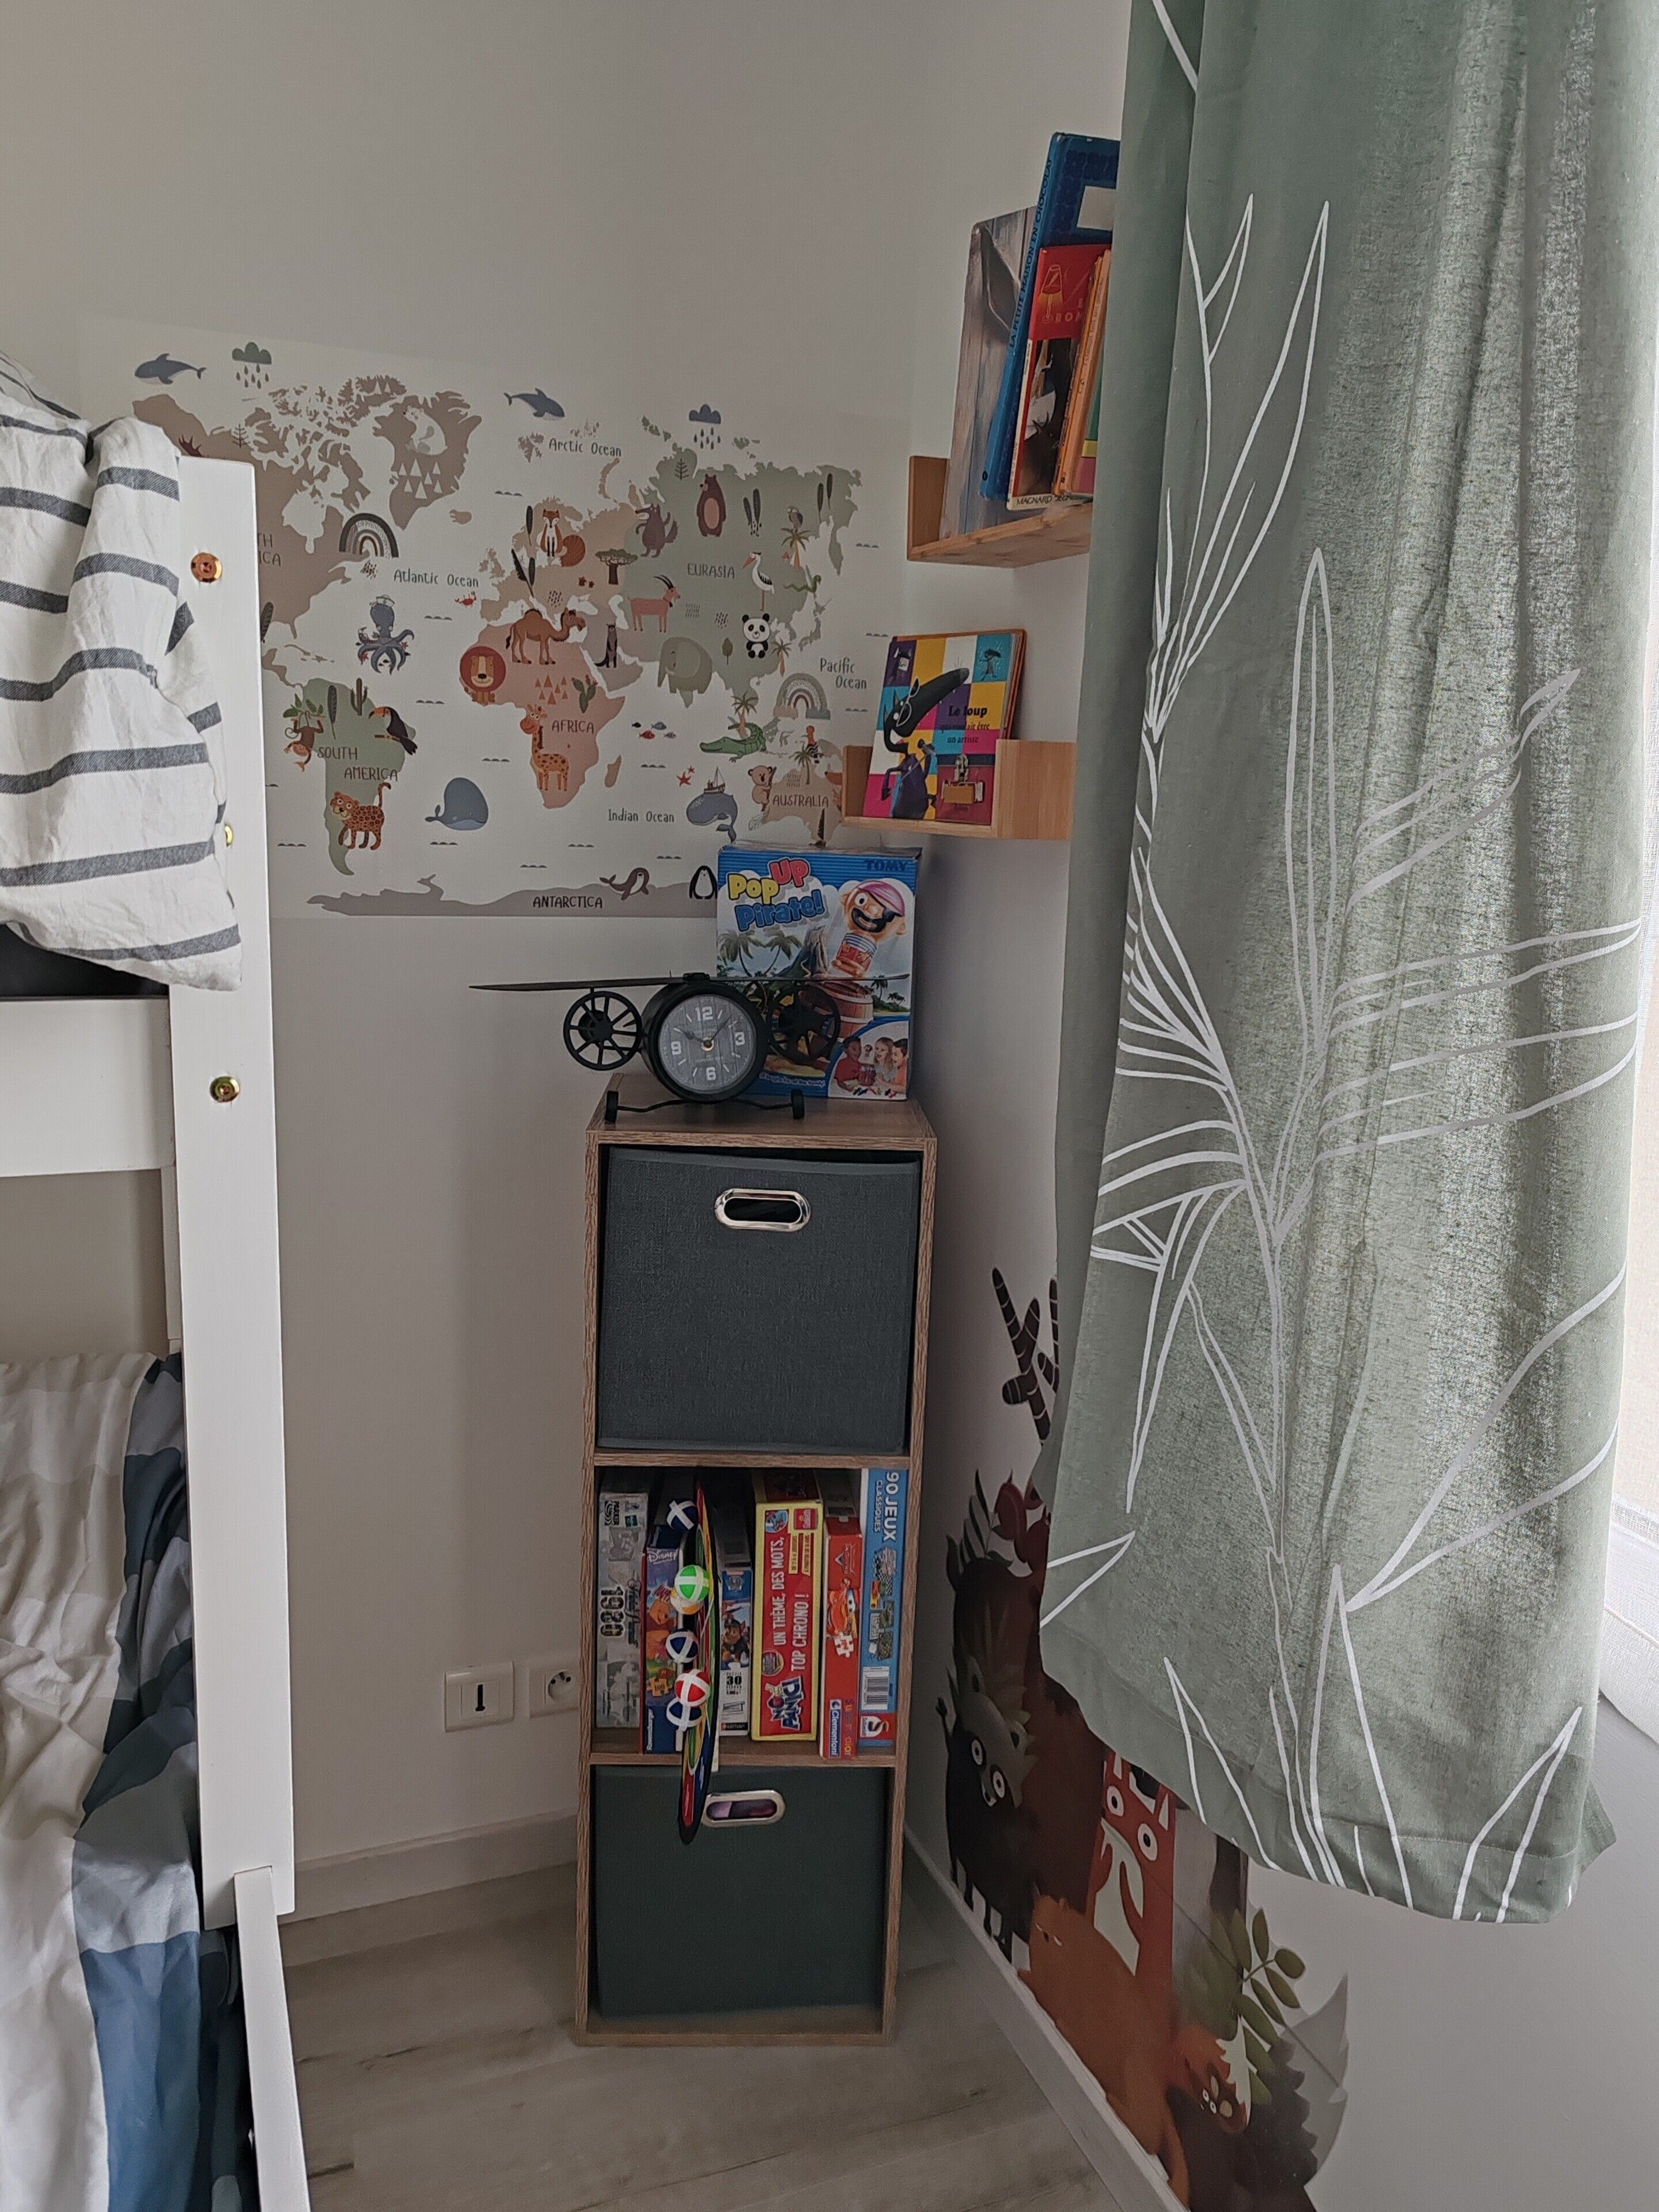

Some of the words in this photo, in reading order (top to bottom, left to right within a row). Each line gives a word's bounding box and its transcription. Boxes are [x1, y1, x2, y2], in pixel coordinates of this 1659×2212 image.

[1034, 158, 1054, 224] CHOCOLAT
[1030, 227, 1039, 243] EN
[1020, 246, 1035, 293] MAISON
[1012, 296, 1025, 331] PETITE
[1007, 334, 1017, 348] LA
[549, 438, 584, 453] Arctic
[590, 441, 622, 457] Ocean
[1017, 495, 1052, 506] MAGNARD
[393, 568, 439, 585] Atlantic
[447, 572, 479, 588] Ocean
[687, 563, 736, 579] EURASIA
[820, 657, 855, 674] Pacific
[836, 674, 868, 690] Ocean
[949, 706, 960, 717] Le
[964, 706, 987, 718] loup
[551, 719, 595, 734] AFRICA
[317, 744, 358, 760] SOUTH
[344, 766, 399, 782] AMERICA
[772, 794, 830, 808] AUSTRALIA
[608, 808, 639, 823] Indian
[646, 809, 675, 824] Ocean
[864, 858, 908, 871] TOMY
[532, 895, 603, 909] ANTARCTICA
[734, 889, 825, 931] Pirate!
[695, 1006, 713, 1021] 12
[735, 1032, 746, 1046] 3
[671, 1041, 681, 1055] 9
[706, 1067, 717, 1081] 6
[885, 1472, 900, 1494] 90
[873, 1479, 882, 1533] CLASSIQUES
[882, 1496, 899, 1541] JEUX
[770, 1536, 786, 1569] MOTS,
[771, 1571, 785, 1589] DES
[601, 1586, 626, 1637] 1980
[770, 1593, 787, 1629] THÈME,
[791, 1603, 809, 1647] CHRONO
[773, 1631, 787, 1646] UN
[790, 1652, 807, 1673] TOP
[726, 1675, 743, 1685] 30
[767, 1695, 785, 1721] NO
[831, 1711, 840, 1756] Clementoni
